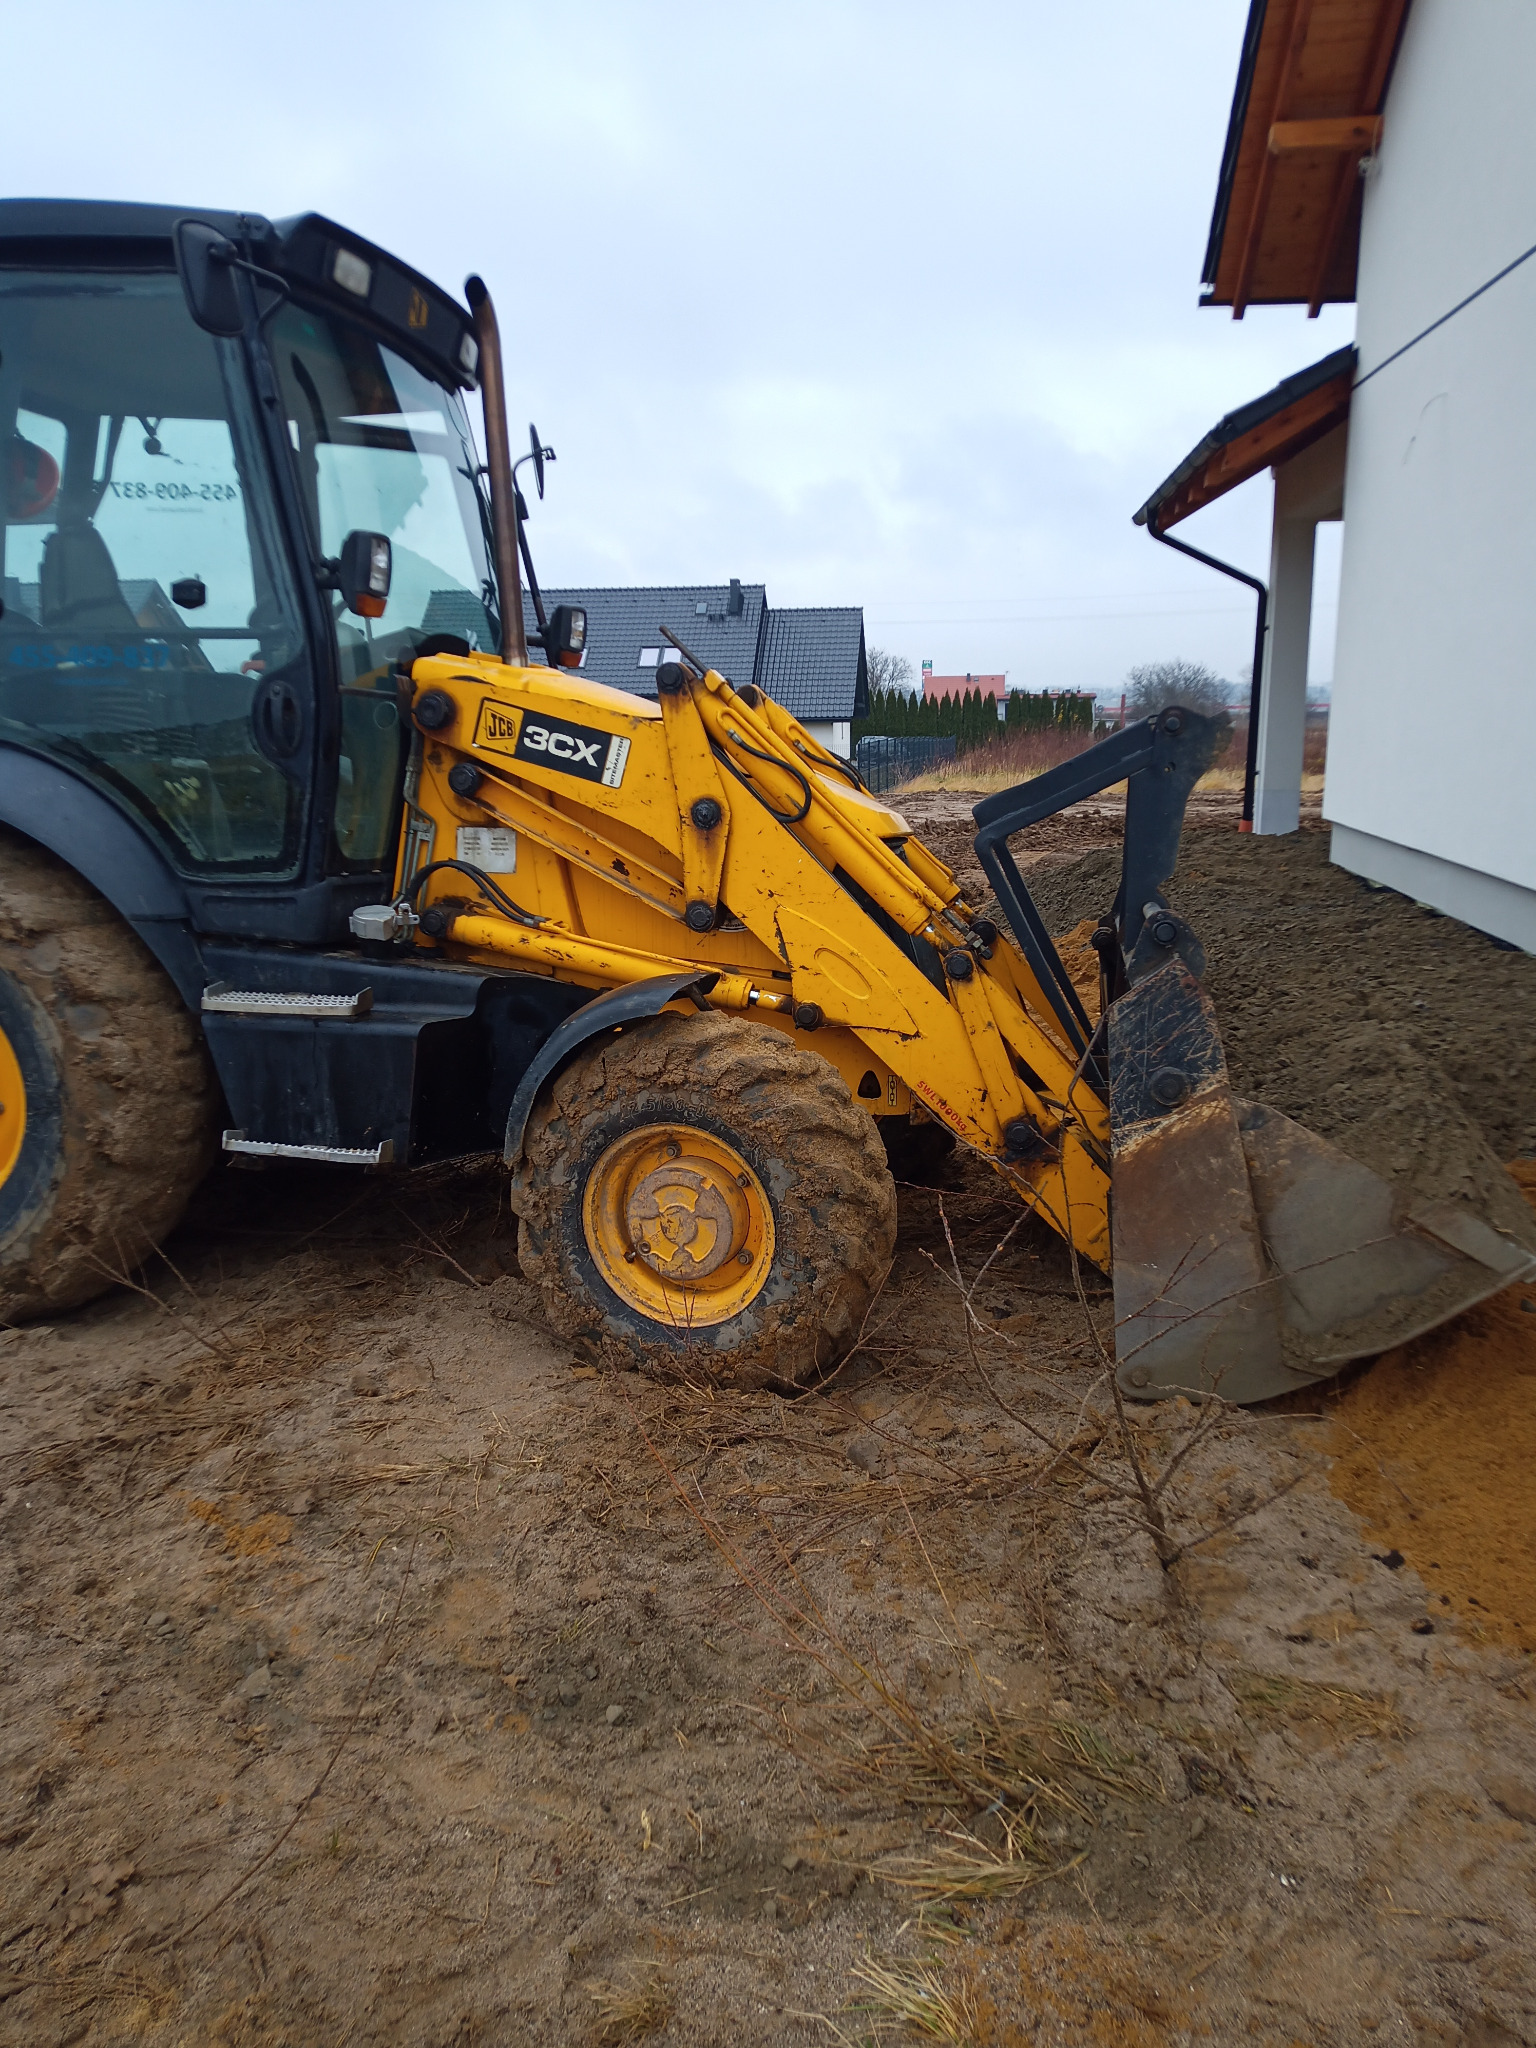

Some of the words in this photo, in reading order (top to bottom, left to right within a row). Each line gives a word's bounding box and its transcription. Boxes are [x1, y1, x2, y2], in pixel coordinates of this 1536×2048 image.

[8, 645, 170, 668] 455-409-837
[488, 712, 514, 737] JCB
[523, 725, 602, 768] 3CX
[609, 737, 624, 785] SITEMASTER
[917, 1080, 936, 1101] SWL
